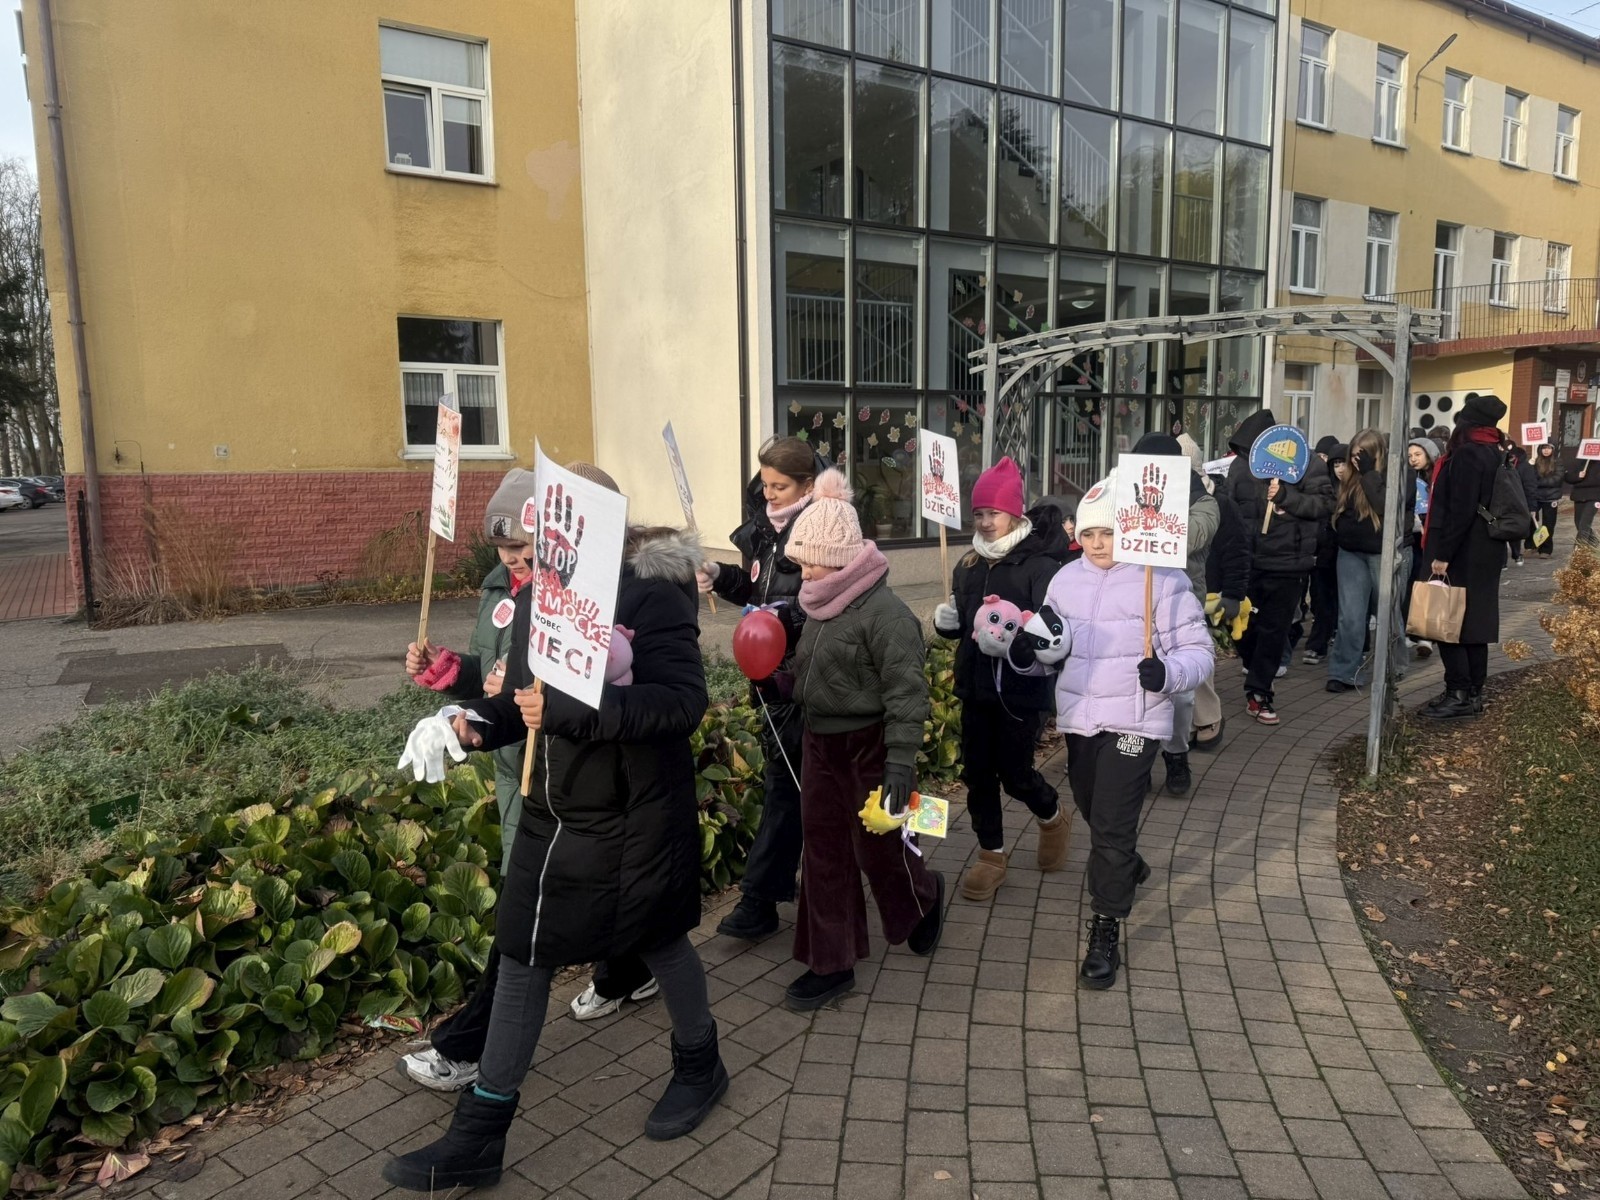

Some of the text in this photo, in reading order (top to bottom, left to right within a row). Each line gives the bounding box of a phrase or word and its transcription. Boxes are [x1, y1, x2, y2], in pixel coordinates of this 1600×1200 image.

[1140, 491, 1163, 506] STOP
[538, 538, 578, 573] STOP
[1121, 537, 1177, 555] DZIECI
[534, 612, 562, 632] WOBEC
